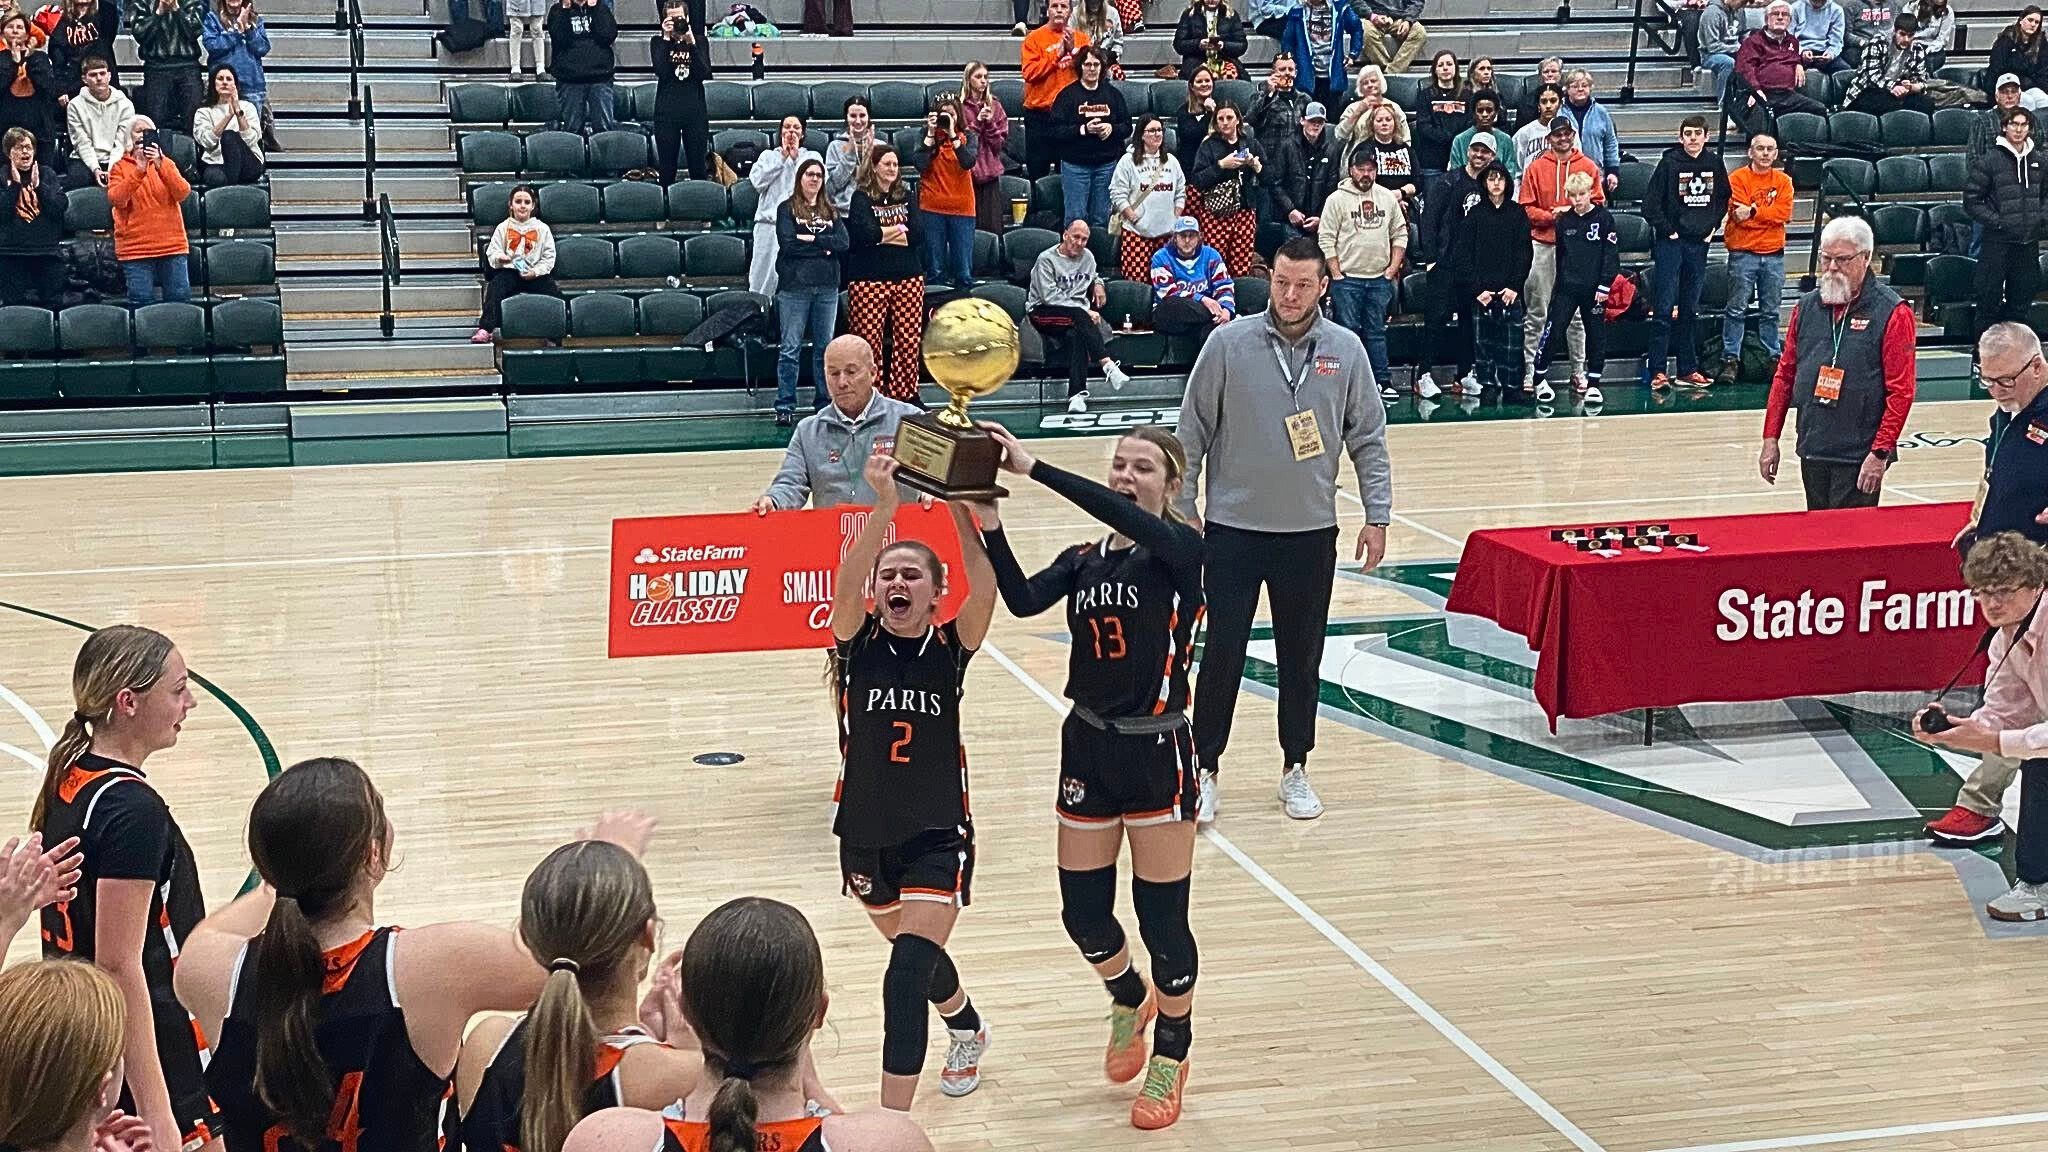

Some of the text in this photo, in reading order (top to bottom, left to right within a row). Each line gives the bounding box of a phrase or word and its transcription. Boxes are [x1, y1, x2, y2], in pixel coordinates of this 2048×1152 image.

[783, 570, 834, 604] SMALL
[1075, 582, 1139, 615] PARIS
[629, 595, 740, 627] CLASSIC
[1715, 579, 1976, 642] State Farm
[1088, 615, 1127, 659] 13
[865, 687, 941, 716] PARIS
[889, 720, 913, 763] 2
